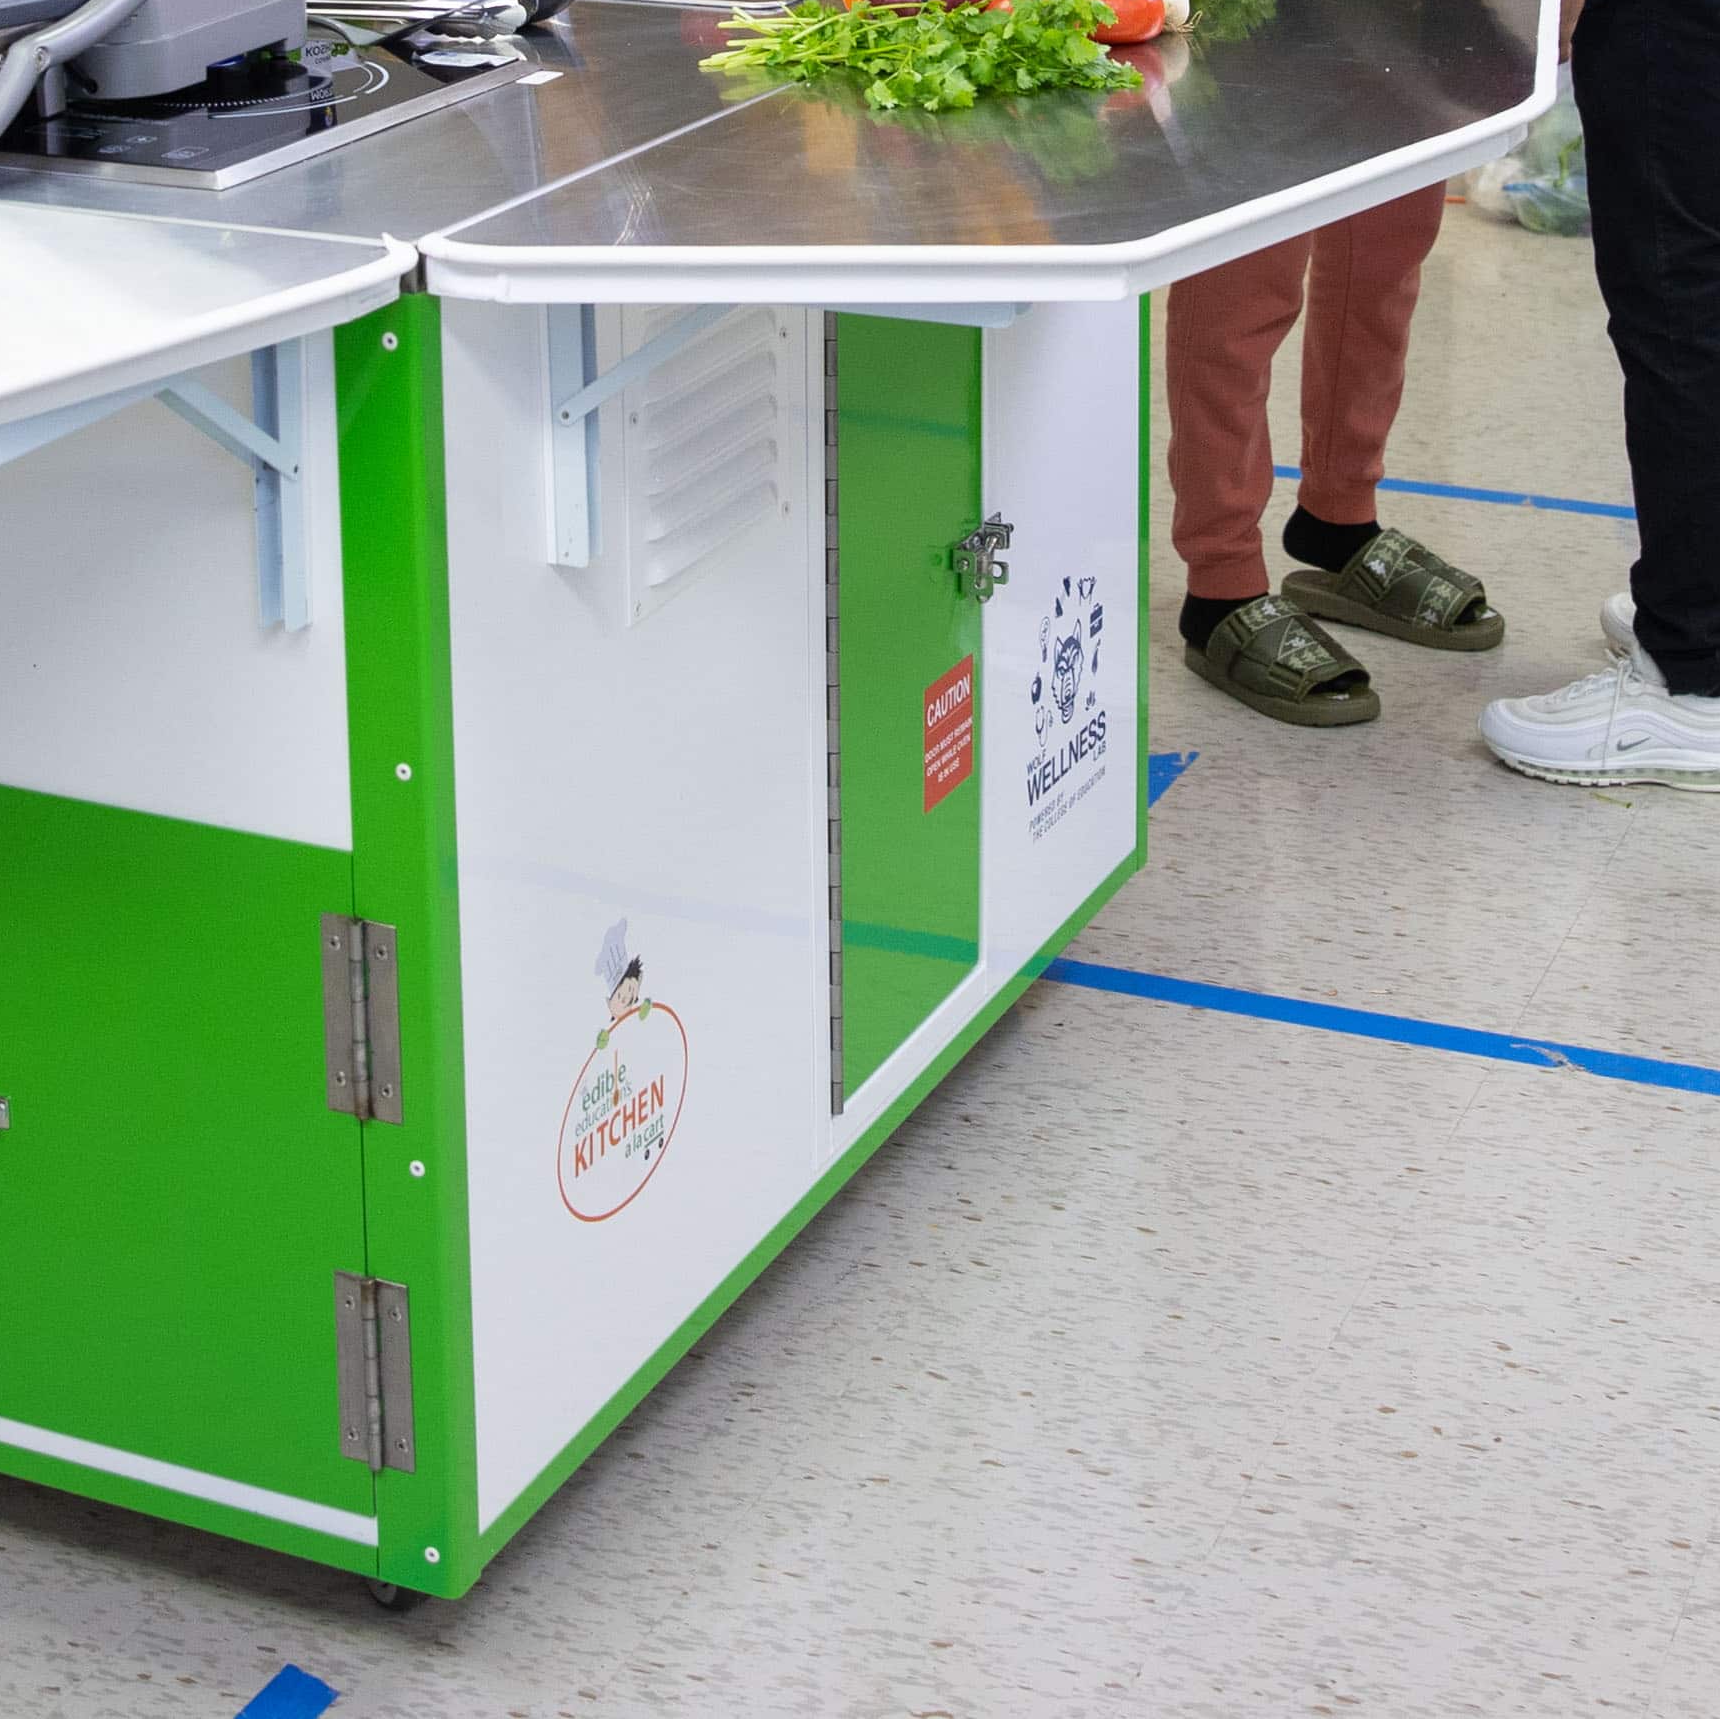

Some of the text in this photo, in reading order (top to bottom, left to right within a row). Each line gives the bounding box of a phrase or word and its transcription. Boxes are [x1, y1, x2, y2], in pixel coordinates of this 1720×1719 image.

[926, 674, 970, 727] CAUTION
[1026, 749, 1046, 774] WOLF
[1027, 710, 1106, 806] WELLNESS
[1092, 740, 1107, 762] LAB
[574, 1074, 664, 1178] KITCHEN
[643, 1114, 664, 1142] cart
